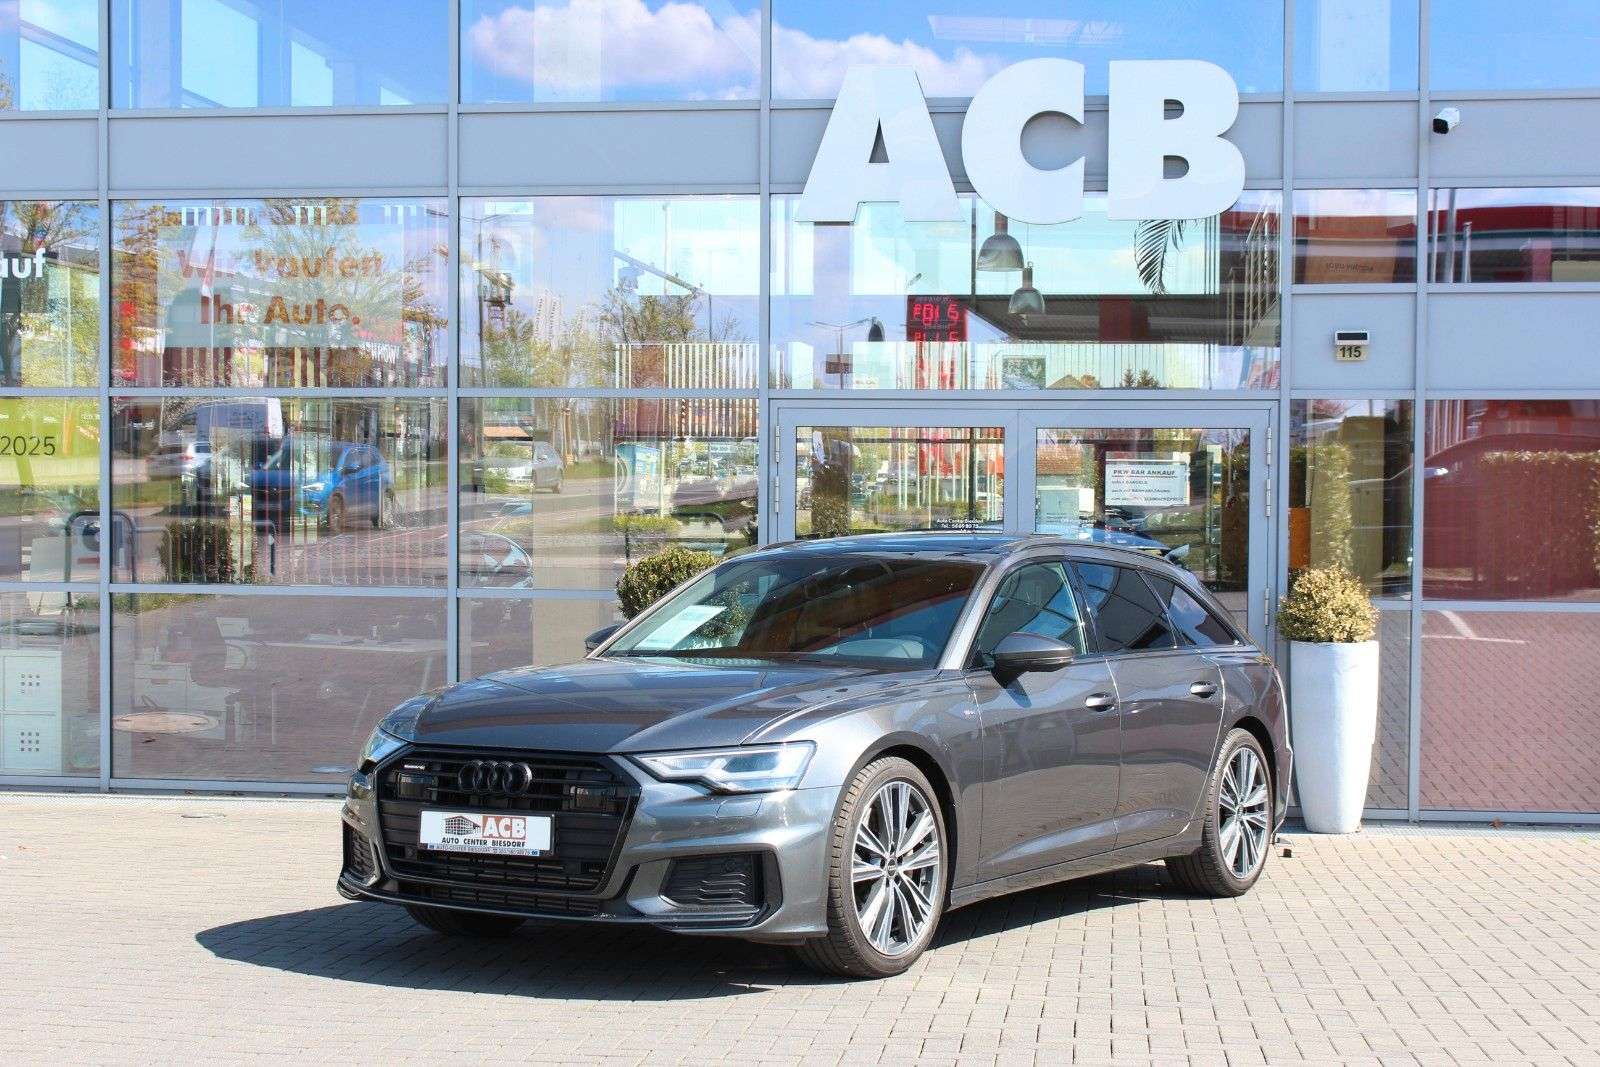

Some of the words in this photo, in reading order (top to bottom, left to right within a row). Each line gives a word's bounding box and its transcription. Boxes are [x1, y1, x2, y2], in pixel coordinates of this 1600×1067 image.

[795, 57, 1246, 225] ACB
[1339, 346, 1362, 358] 115
[0, 435, 56, 456] 2025
[483, 816, 526, 839] ACB
[441, 837, 460, 845] AUTO
[463, 838, 488, 847] CENTER
[491, 839, 527, 848] BIESDORF
